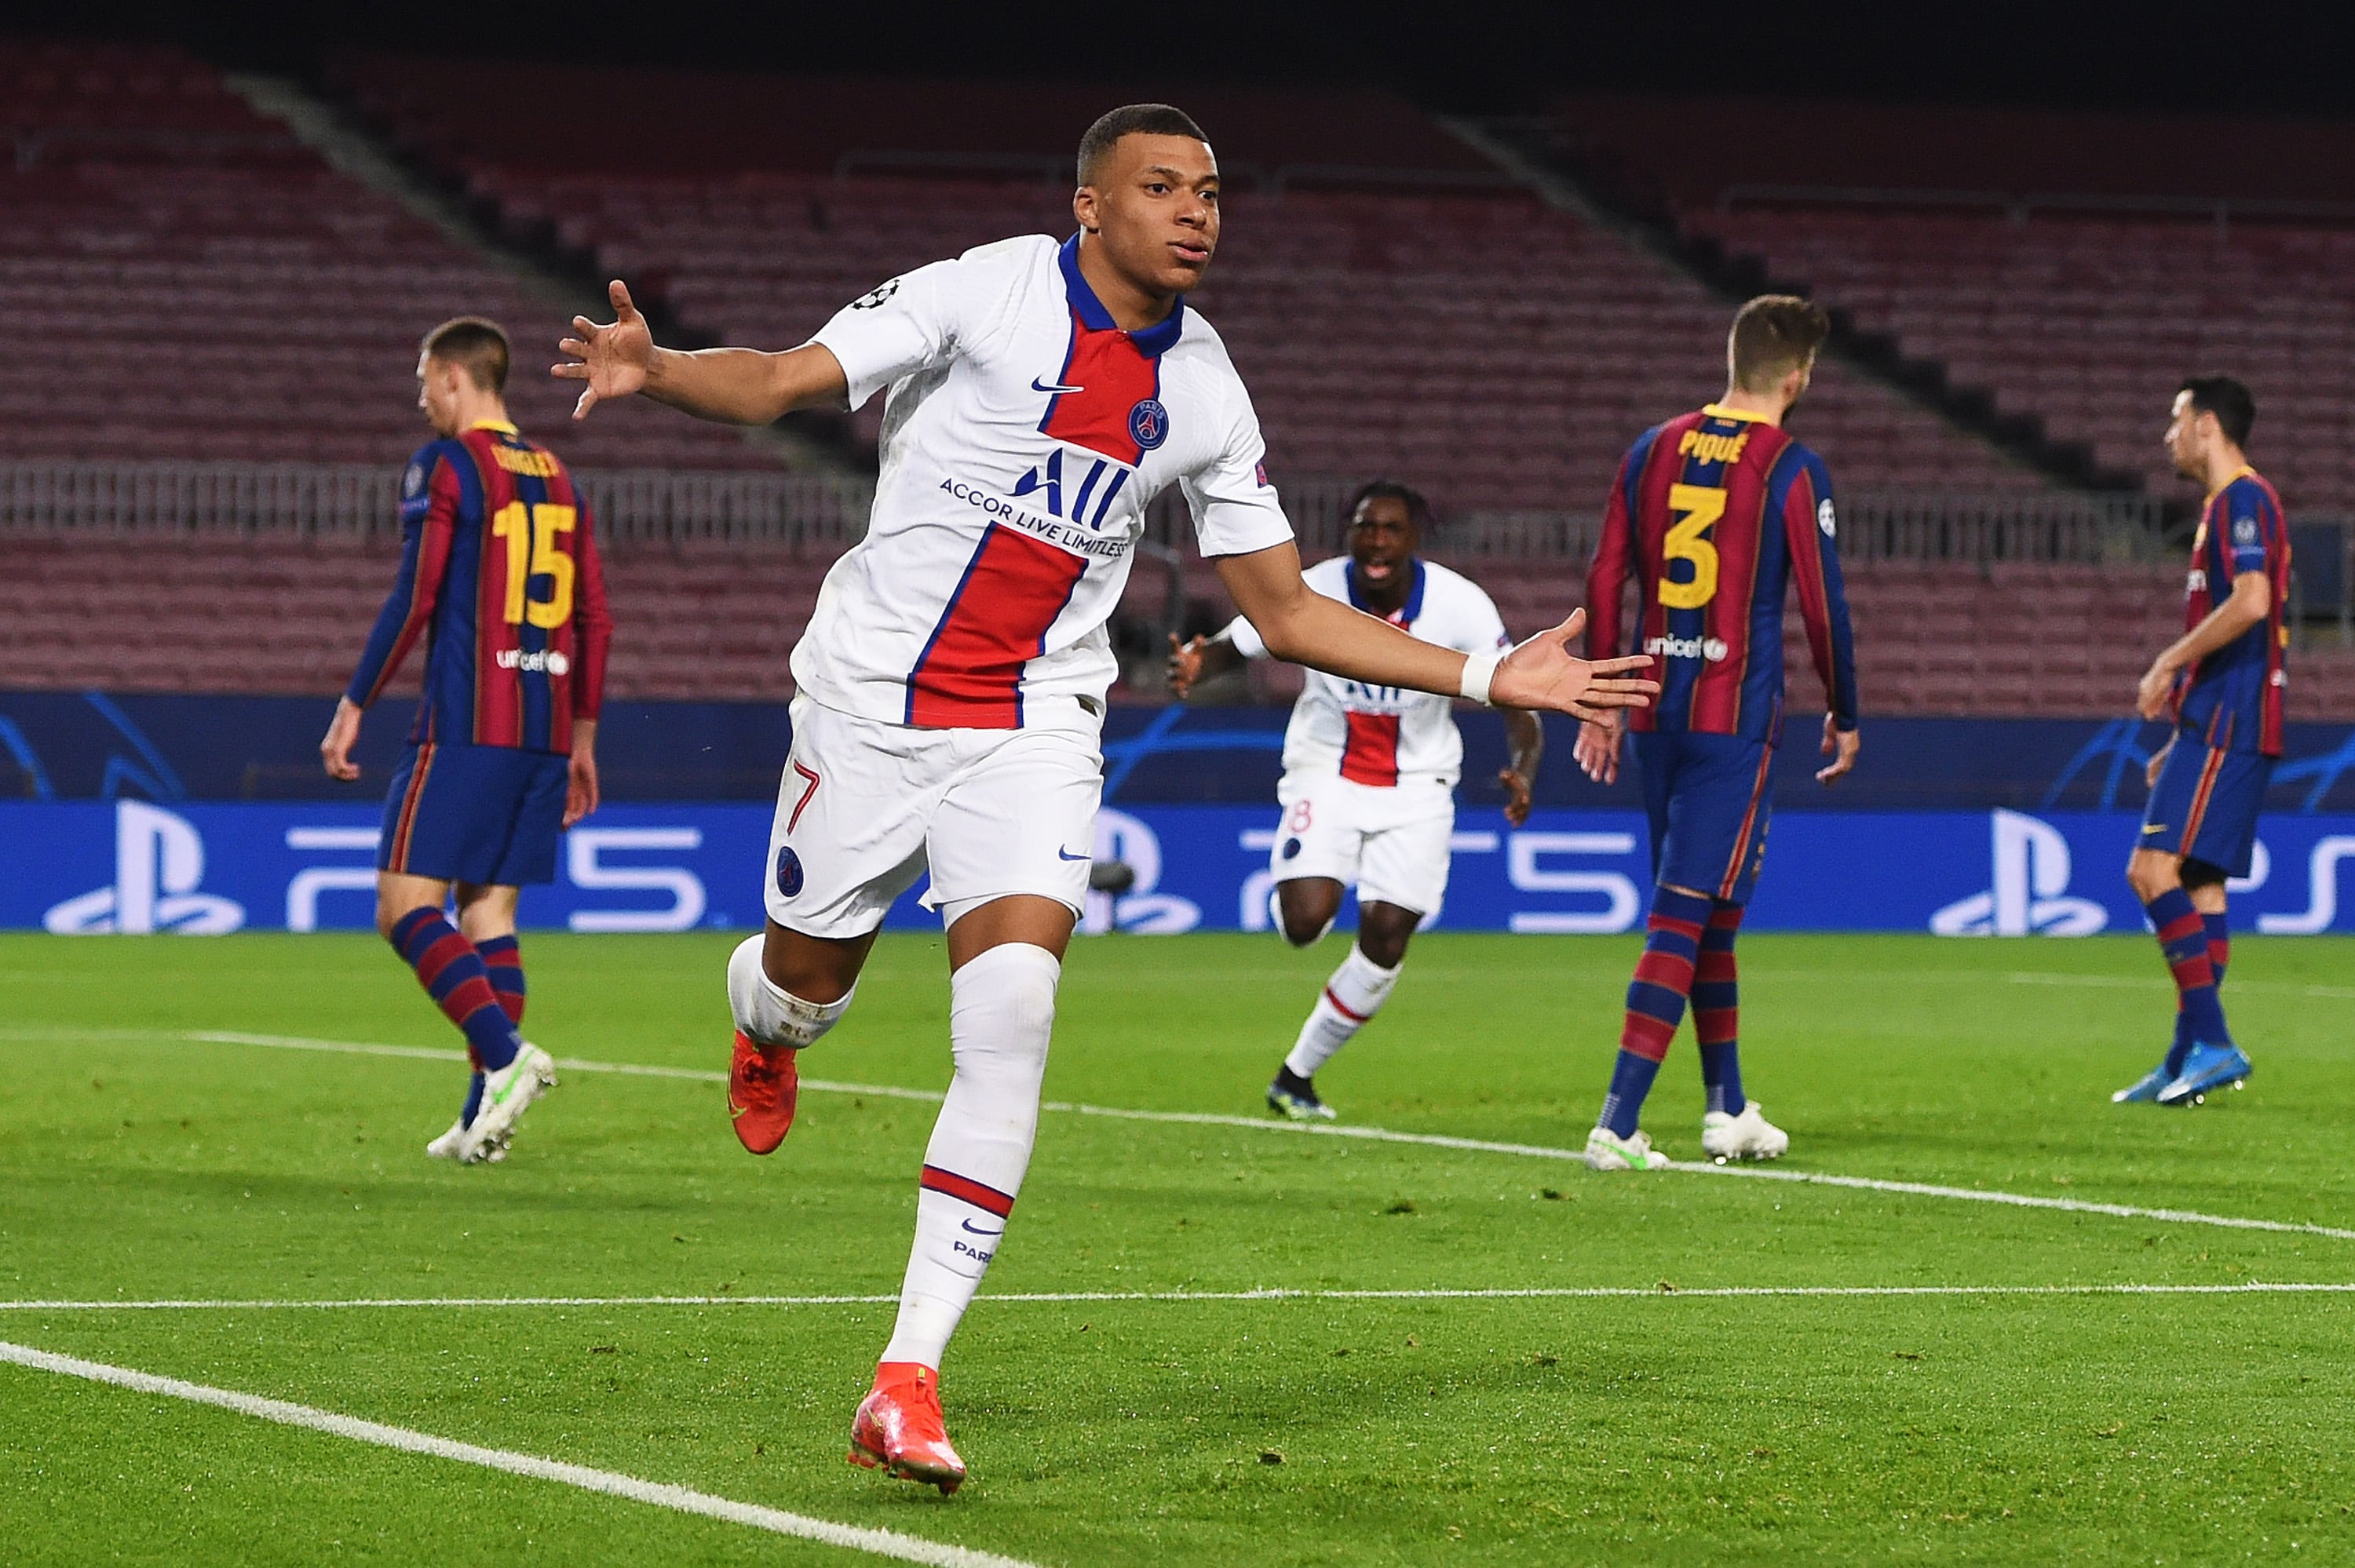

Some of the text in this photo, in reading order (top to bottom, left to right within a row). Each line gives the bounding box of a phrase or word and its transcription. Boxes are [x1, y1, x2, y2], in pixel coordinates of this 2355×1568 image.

[1139, 402, 1163, 419] PARIS
[940, 477, 1128, 557] ACCOR LIVE LIMITLESS
[1658, 483, 1727, 609] 3
[492, 500, 577, 629] 15
[1643, 633, 1702, 658] unicef
[787, 759, 820, 836] 7
